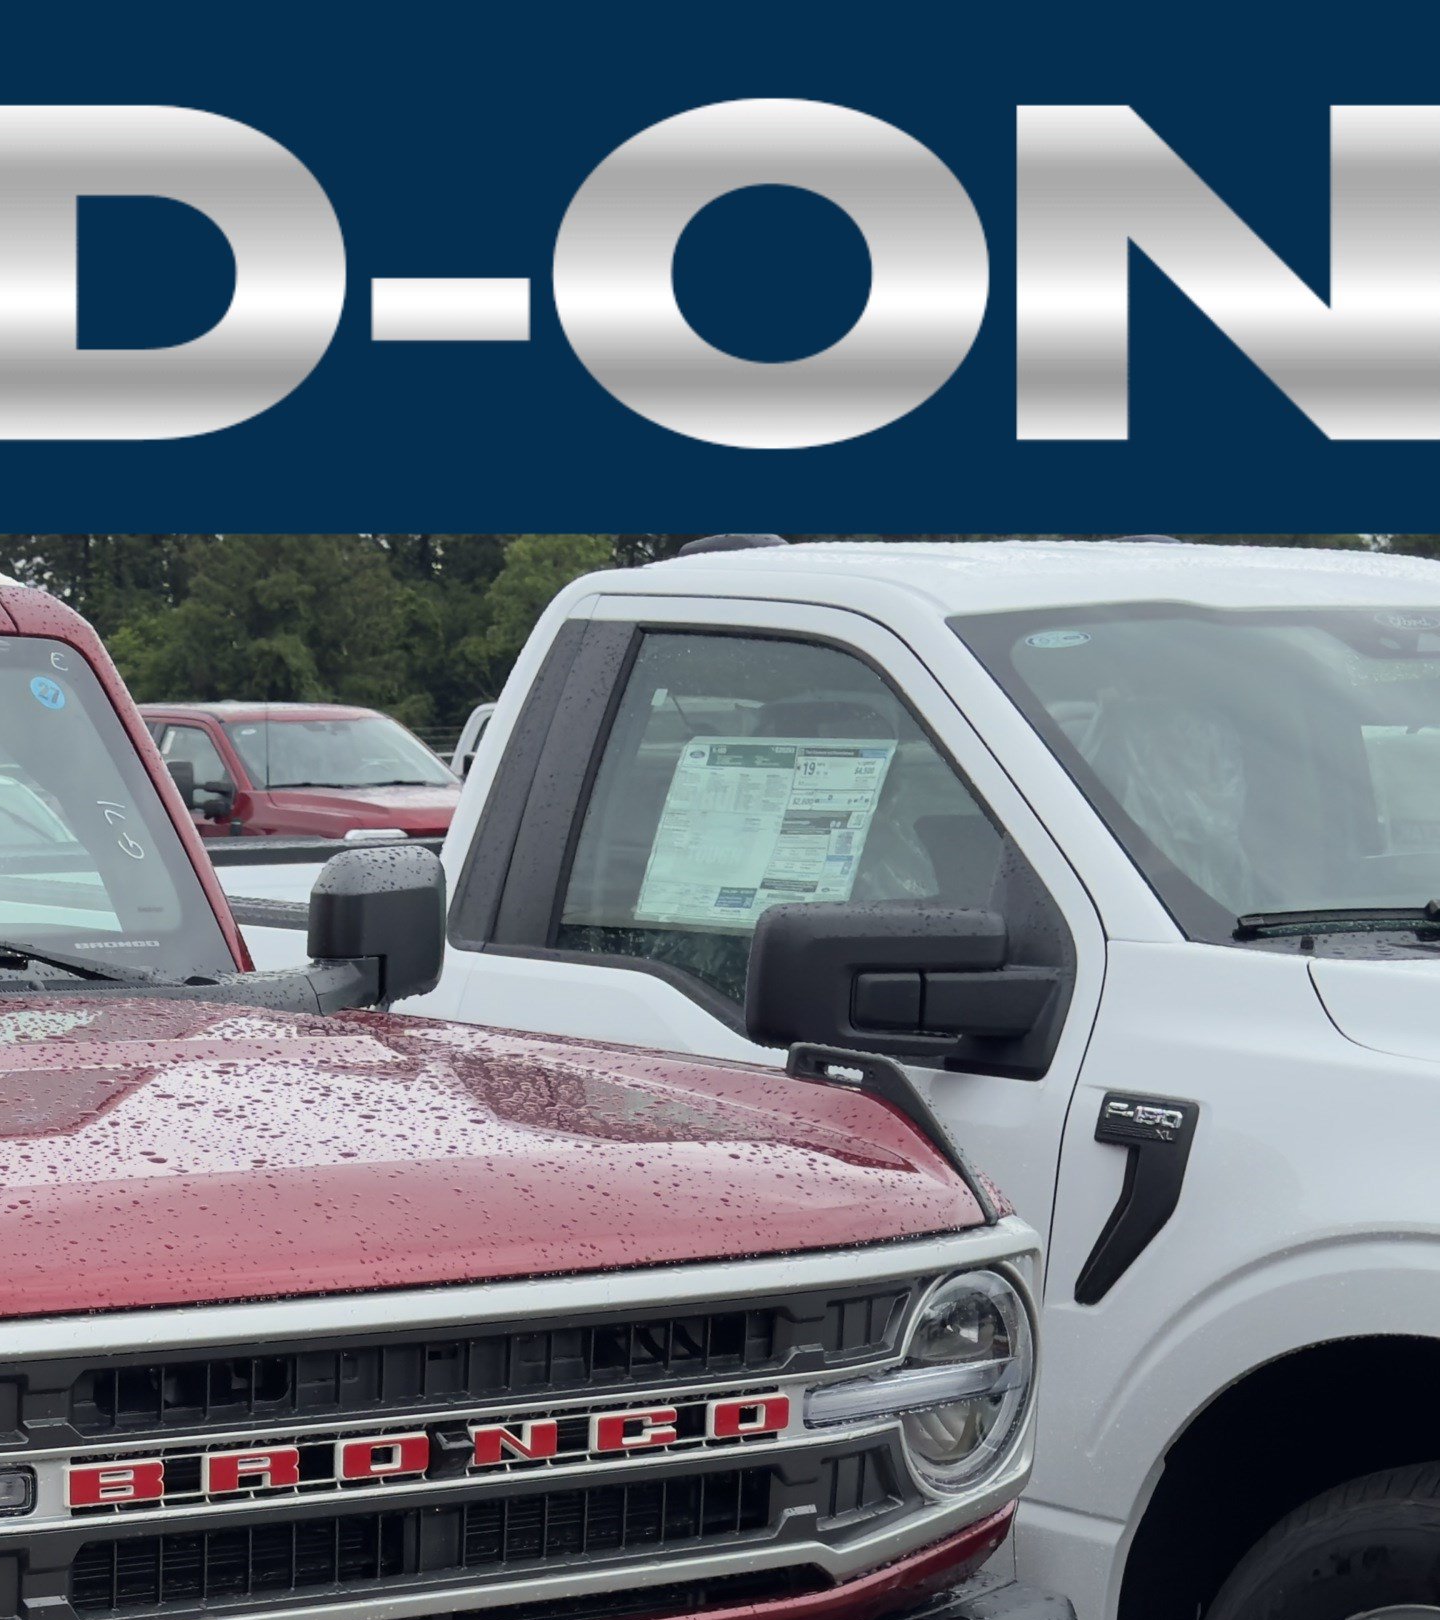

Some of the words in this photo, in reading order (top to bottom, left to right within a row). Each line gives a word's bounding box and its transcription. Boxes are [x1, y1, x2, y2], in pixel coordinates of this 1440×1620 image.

[803, 761, 817, 776] 19
[74, 940, 160, 950] BRONCO
[63, 1395, 790, 1508] BRONCO
